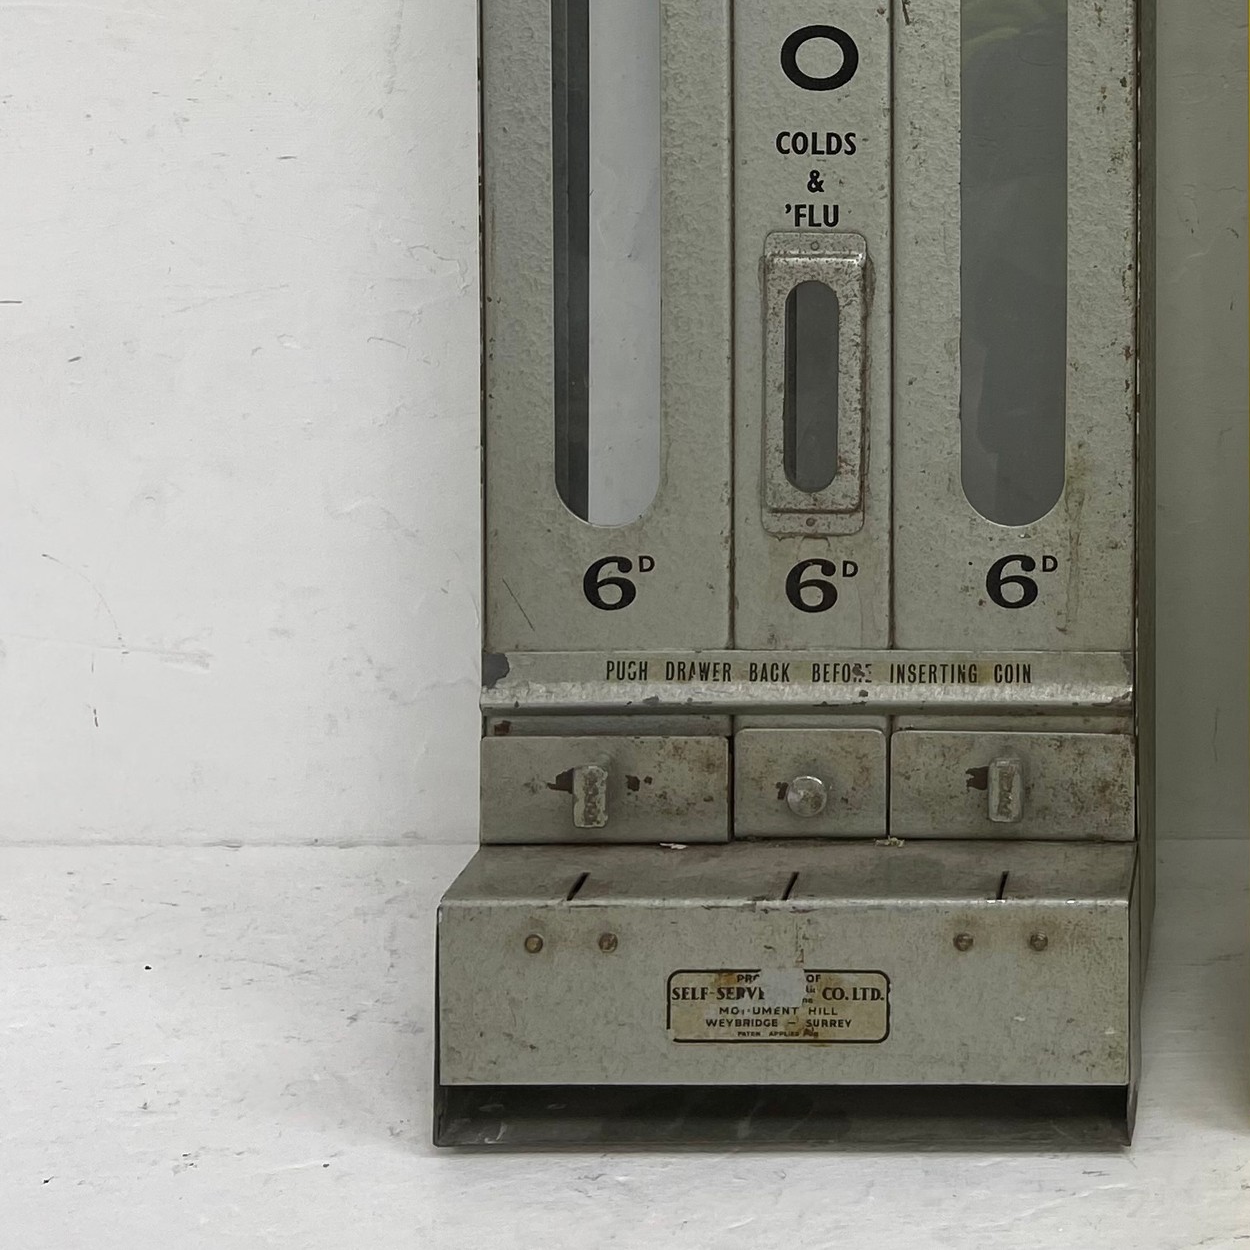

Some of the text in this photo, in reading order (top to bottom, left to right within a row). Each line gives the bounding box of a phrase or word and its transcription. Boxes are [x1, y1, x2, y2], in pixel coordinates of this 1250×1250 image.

[775, 131, 857, 156] COLDS
[807, 169, 825, 193] &
[785, 203, 840, 228] 'FLU
[666, 661, 732, 682] DRAWER
[749, 662, 790, 683] BACK
[890, 663, 978, 684] INSERTING
[994, 663, 1031, 684] COIN
[806, 973, 821, 984] OF
[822, 986, 849, 1002] CO.
[852, 987, 885, 1002] LTD.
[808, 1006, 838, 1016] HILL
[705, 1018, 778, 1028] WEYBRIDGE
[805, 1018, 852, 1029] SURREY
